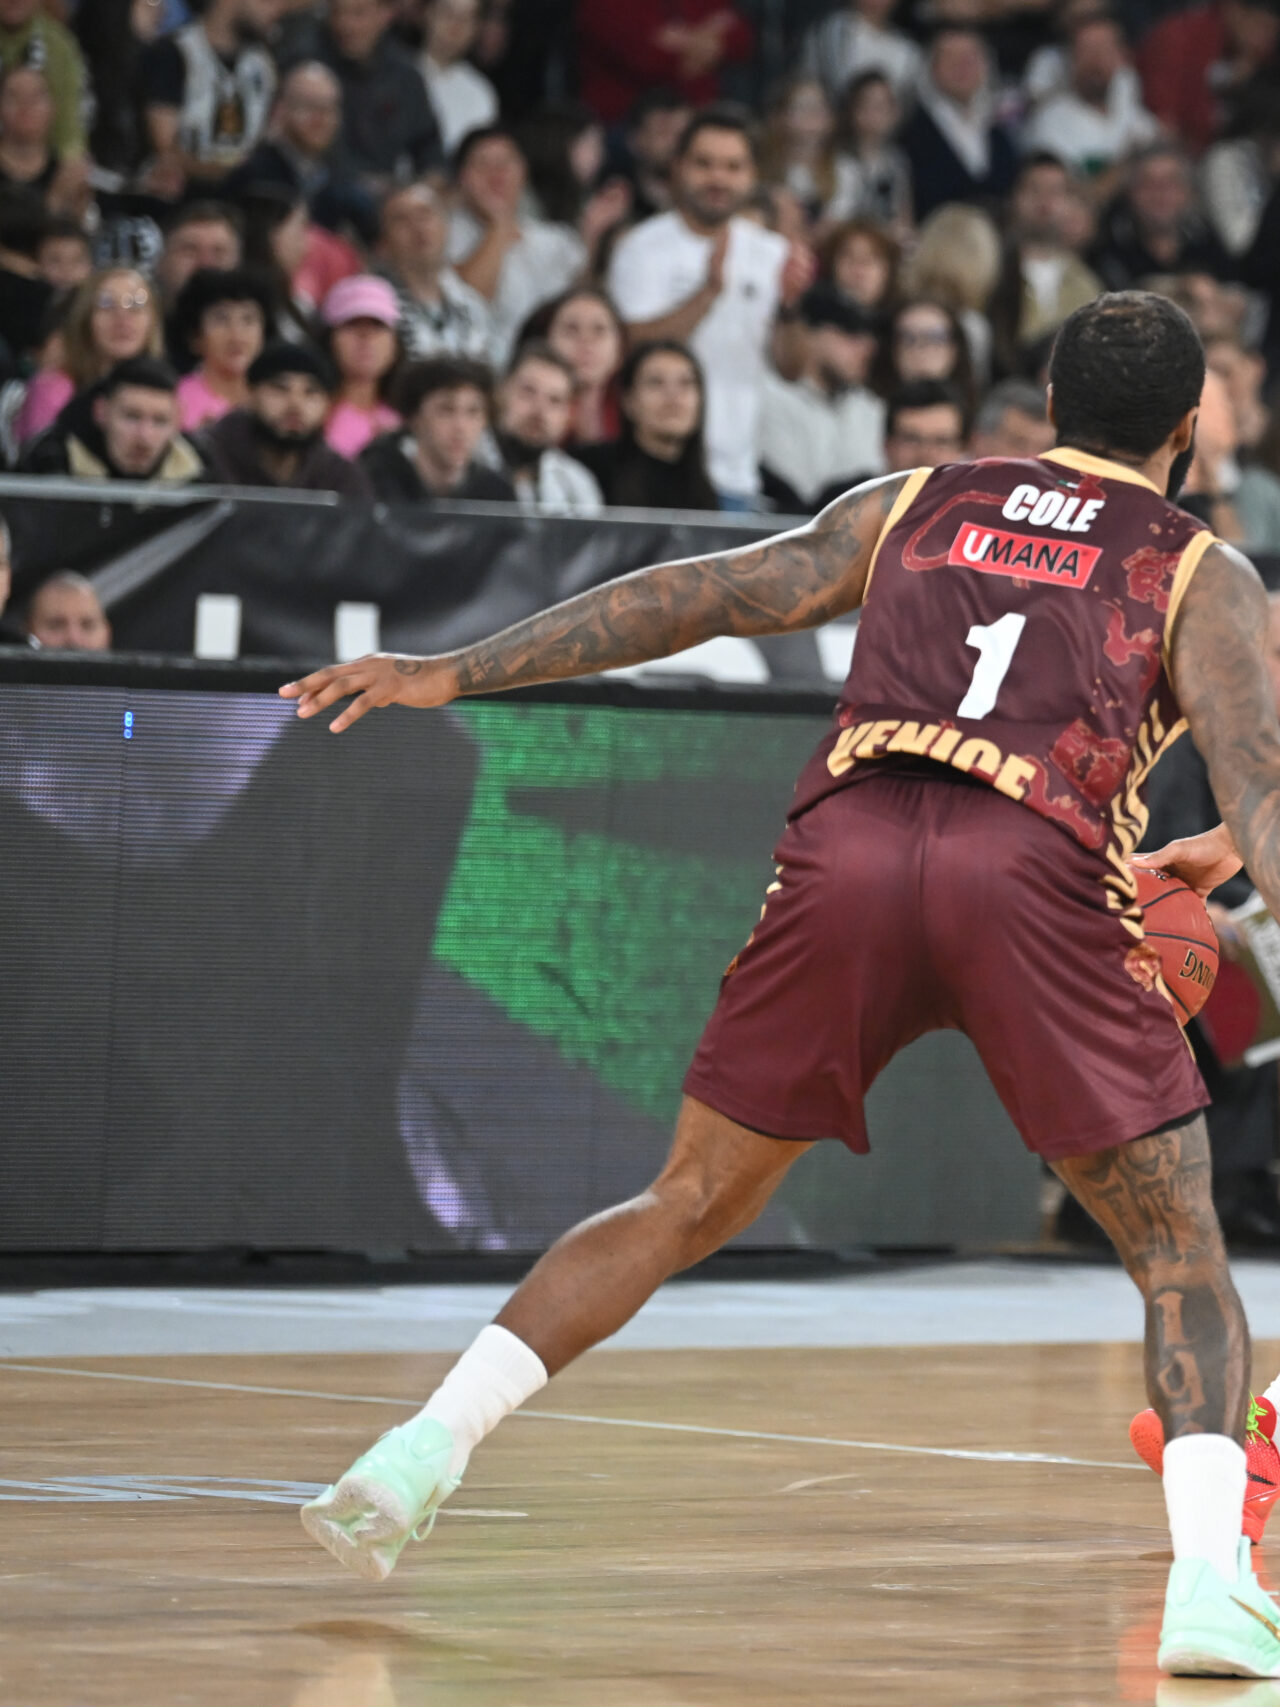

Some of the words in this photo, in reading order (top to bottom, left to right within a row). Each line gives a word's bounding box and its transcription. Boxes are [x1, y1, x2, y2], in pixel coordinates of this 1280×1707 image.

[1001, 484, 1106, 533] COLE
[962, 529, 1080, 578] UMANA
[956, 612, 1027, 720] 1
